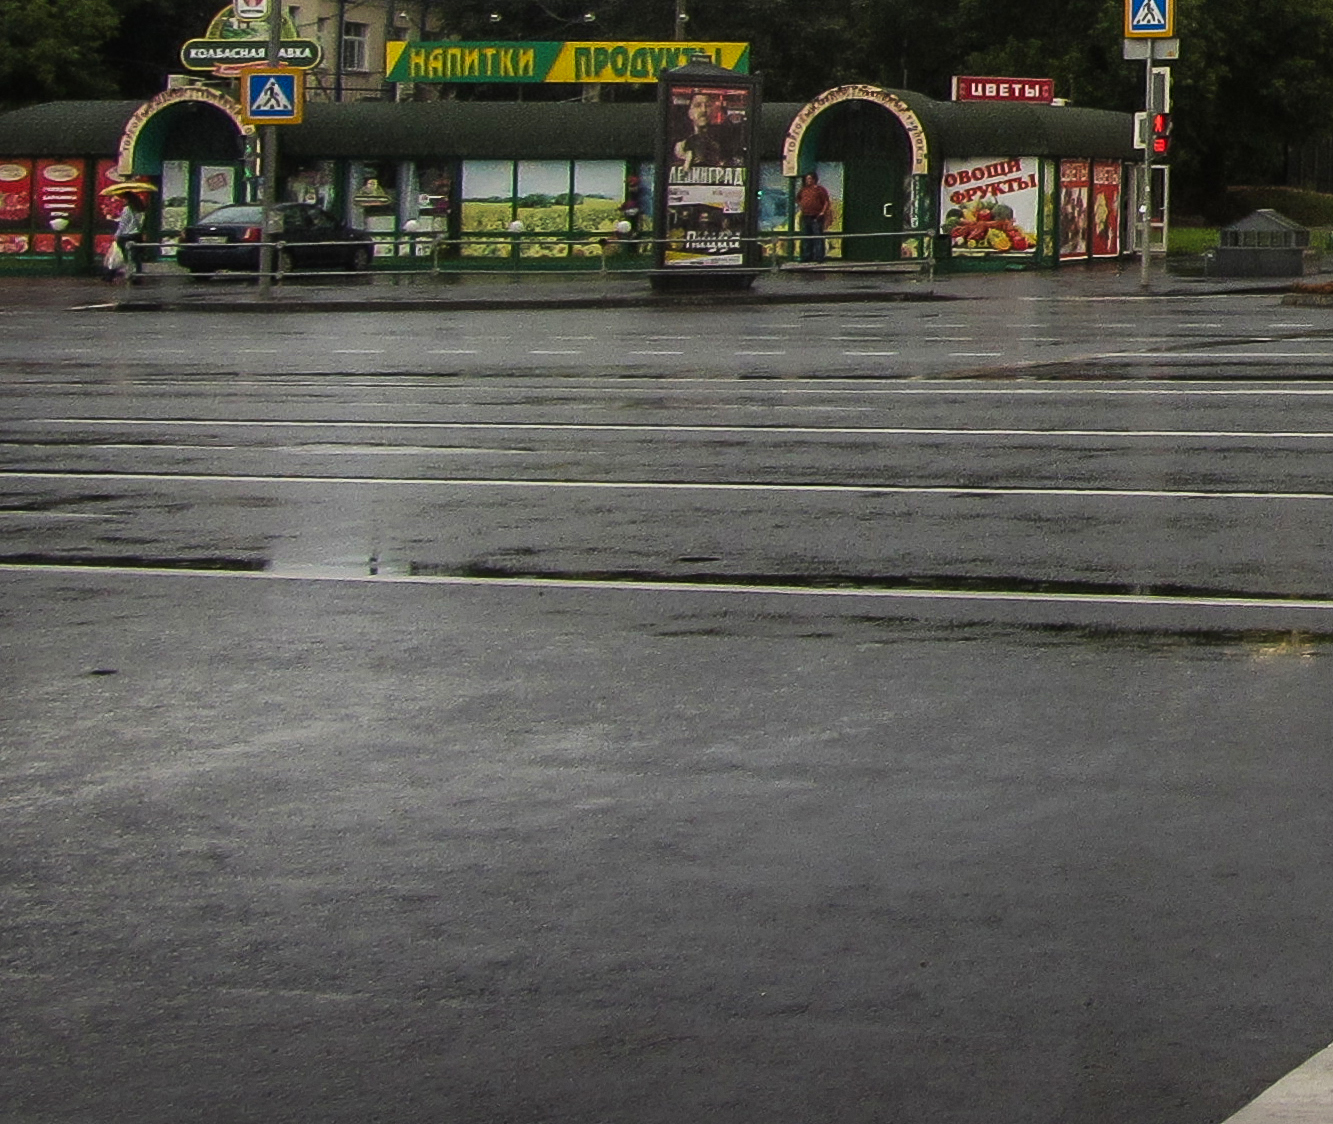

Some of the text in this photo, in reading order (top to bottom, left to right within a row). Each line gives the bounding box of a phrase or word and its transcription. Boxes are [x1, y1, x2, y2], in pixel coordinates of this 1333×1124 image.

[189, 47, 312, 59] КОЛБАСНАЯ АВКА
[408, 47, 536, 77] НАПИТКИ
[971, 82, 1040, 97] ЦВЕТЫ
[669, 166, 744, 186] ЛЕНИНГРАД
[944, 157, 1023, 188] ОВОЩИ
[950, 174, 1039, 205] ФРУКТЫ
